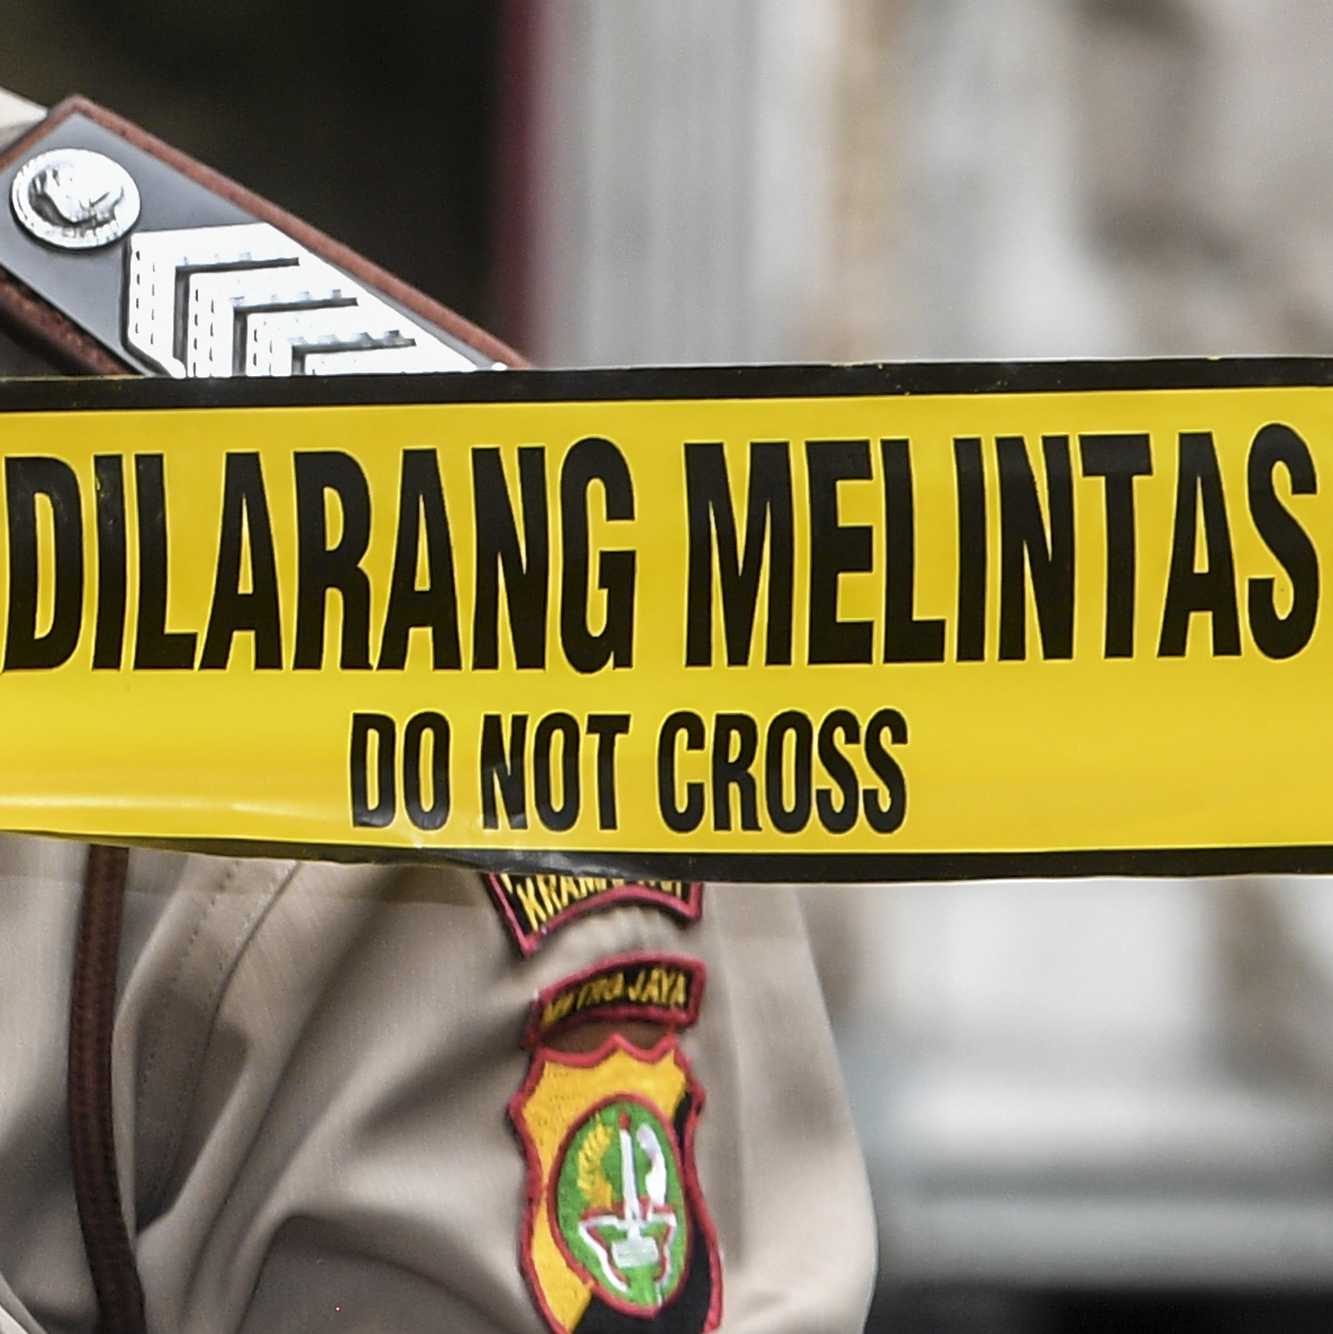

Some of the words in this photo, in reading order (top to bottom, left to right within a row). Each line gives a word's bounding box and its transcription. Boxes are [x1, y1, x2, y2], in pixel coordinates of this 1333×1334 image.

[1, 437, 637, 674] DILARANG
[683, 423, 1320, 668] MELINTAS
[349, 711, 451, 831] DO
[479, 713, 631, 832] NOT
[657, 708, 908, 834] CROSS
[628, 966, 687, 1006] JAYA
